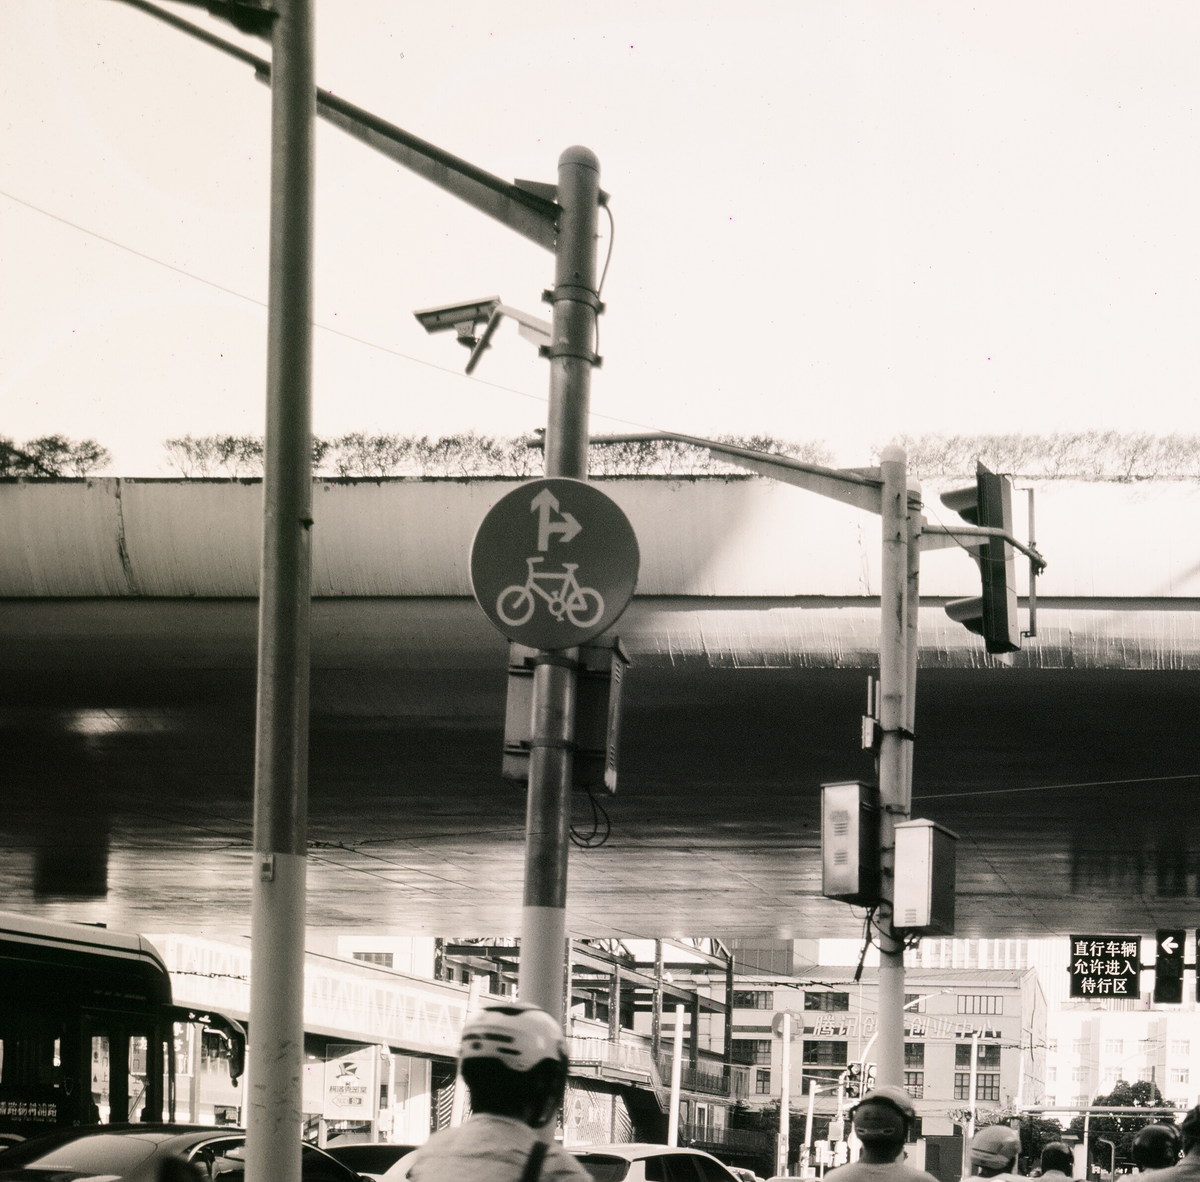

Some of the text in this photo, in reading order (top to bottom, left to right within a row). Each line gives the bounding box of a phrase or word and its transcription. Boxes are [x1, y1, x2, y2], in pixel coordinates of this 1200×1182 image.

[1074, 941, 1137, 958] 直行车辆
[1074, 960, 1136, 975] 允许进入
[1081, 978, 1128, 994] 待行区
[813, 1014, 997, 1040] 腾讯创创业中心
